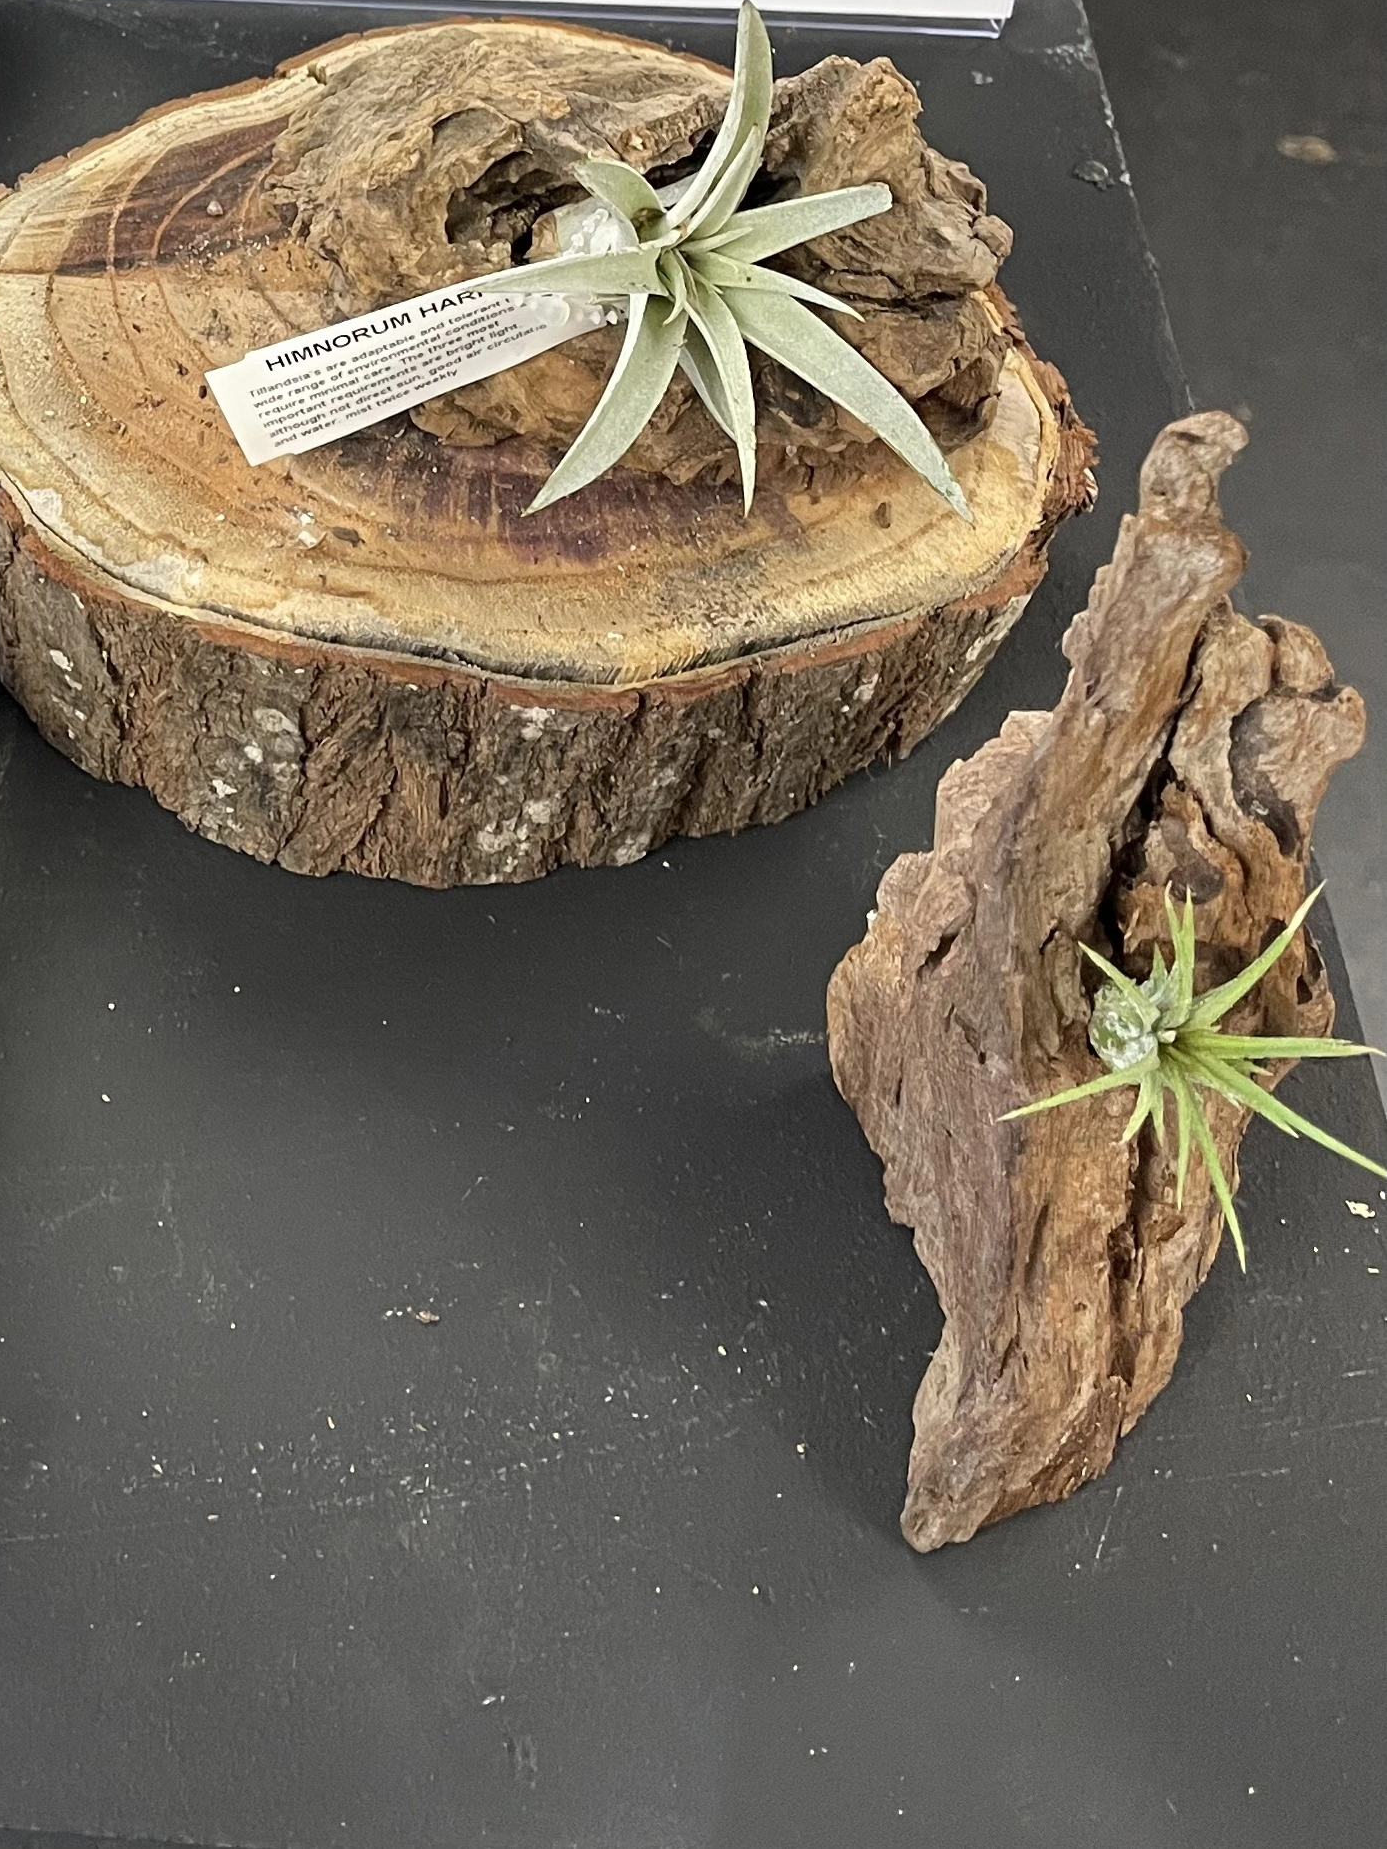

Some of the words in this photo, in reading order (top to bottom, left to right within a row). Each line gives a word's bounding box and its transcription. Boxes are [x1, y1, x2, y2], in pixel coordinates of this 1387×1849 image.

[253, 393, 284, 409] wide
[287, 378, 326, 398] range
[329, 370, 344, 382] of
[346, 333, 442, 375] environmental
[444, 305, 515, 337] conditions
[258, 397, 305, 419] require
[308, 376, 360, 401] minimal
[400, 351, 425, 366] The
[427, 335, 463, 354] three
[466, 320, 500, 338] most
[266, 312, 411, 371] HIMNORUM
[419, 290, 483, 318] HAR
[325, 359, 347, 372] are
[350, 333, 416, 363] adaptable
[419, 321, 445, 337] and
[448, 300, 501, 325] tolerant
[262, 399, 327, 429] important
[329, 364, 418, 404] requirements
[421, 354, 443, 368] are
[445, 336, 486, 357] bright
[268, 412, 327, 439] although
[329, 402, 351, 416] not
[354, 385, 393, 405] direct
[427, 356, 463, 376] good
[465, 347, 483, 360] air
[273, 433, 298, 448] and
[344, 404, 373, 419] mist
[375, 389, 410, 407] twice
[413, 368, 459, 391] weekly
